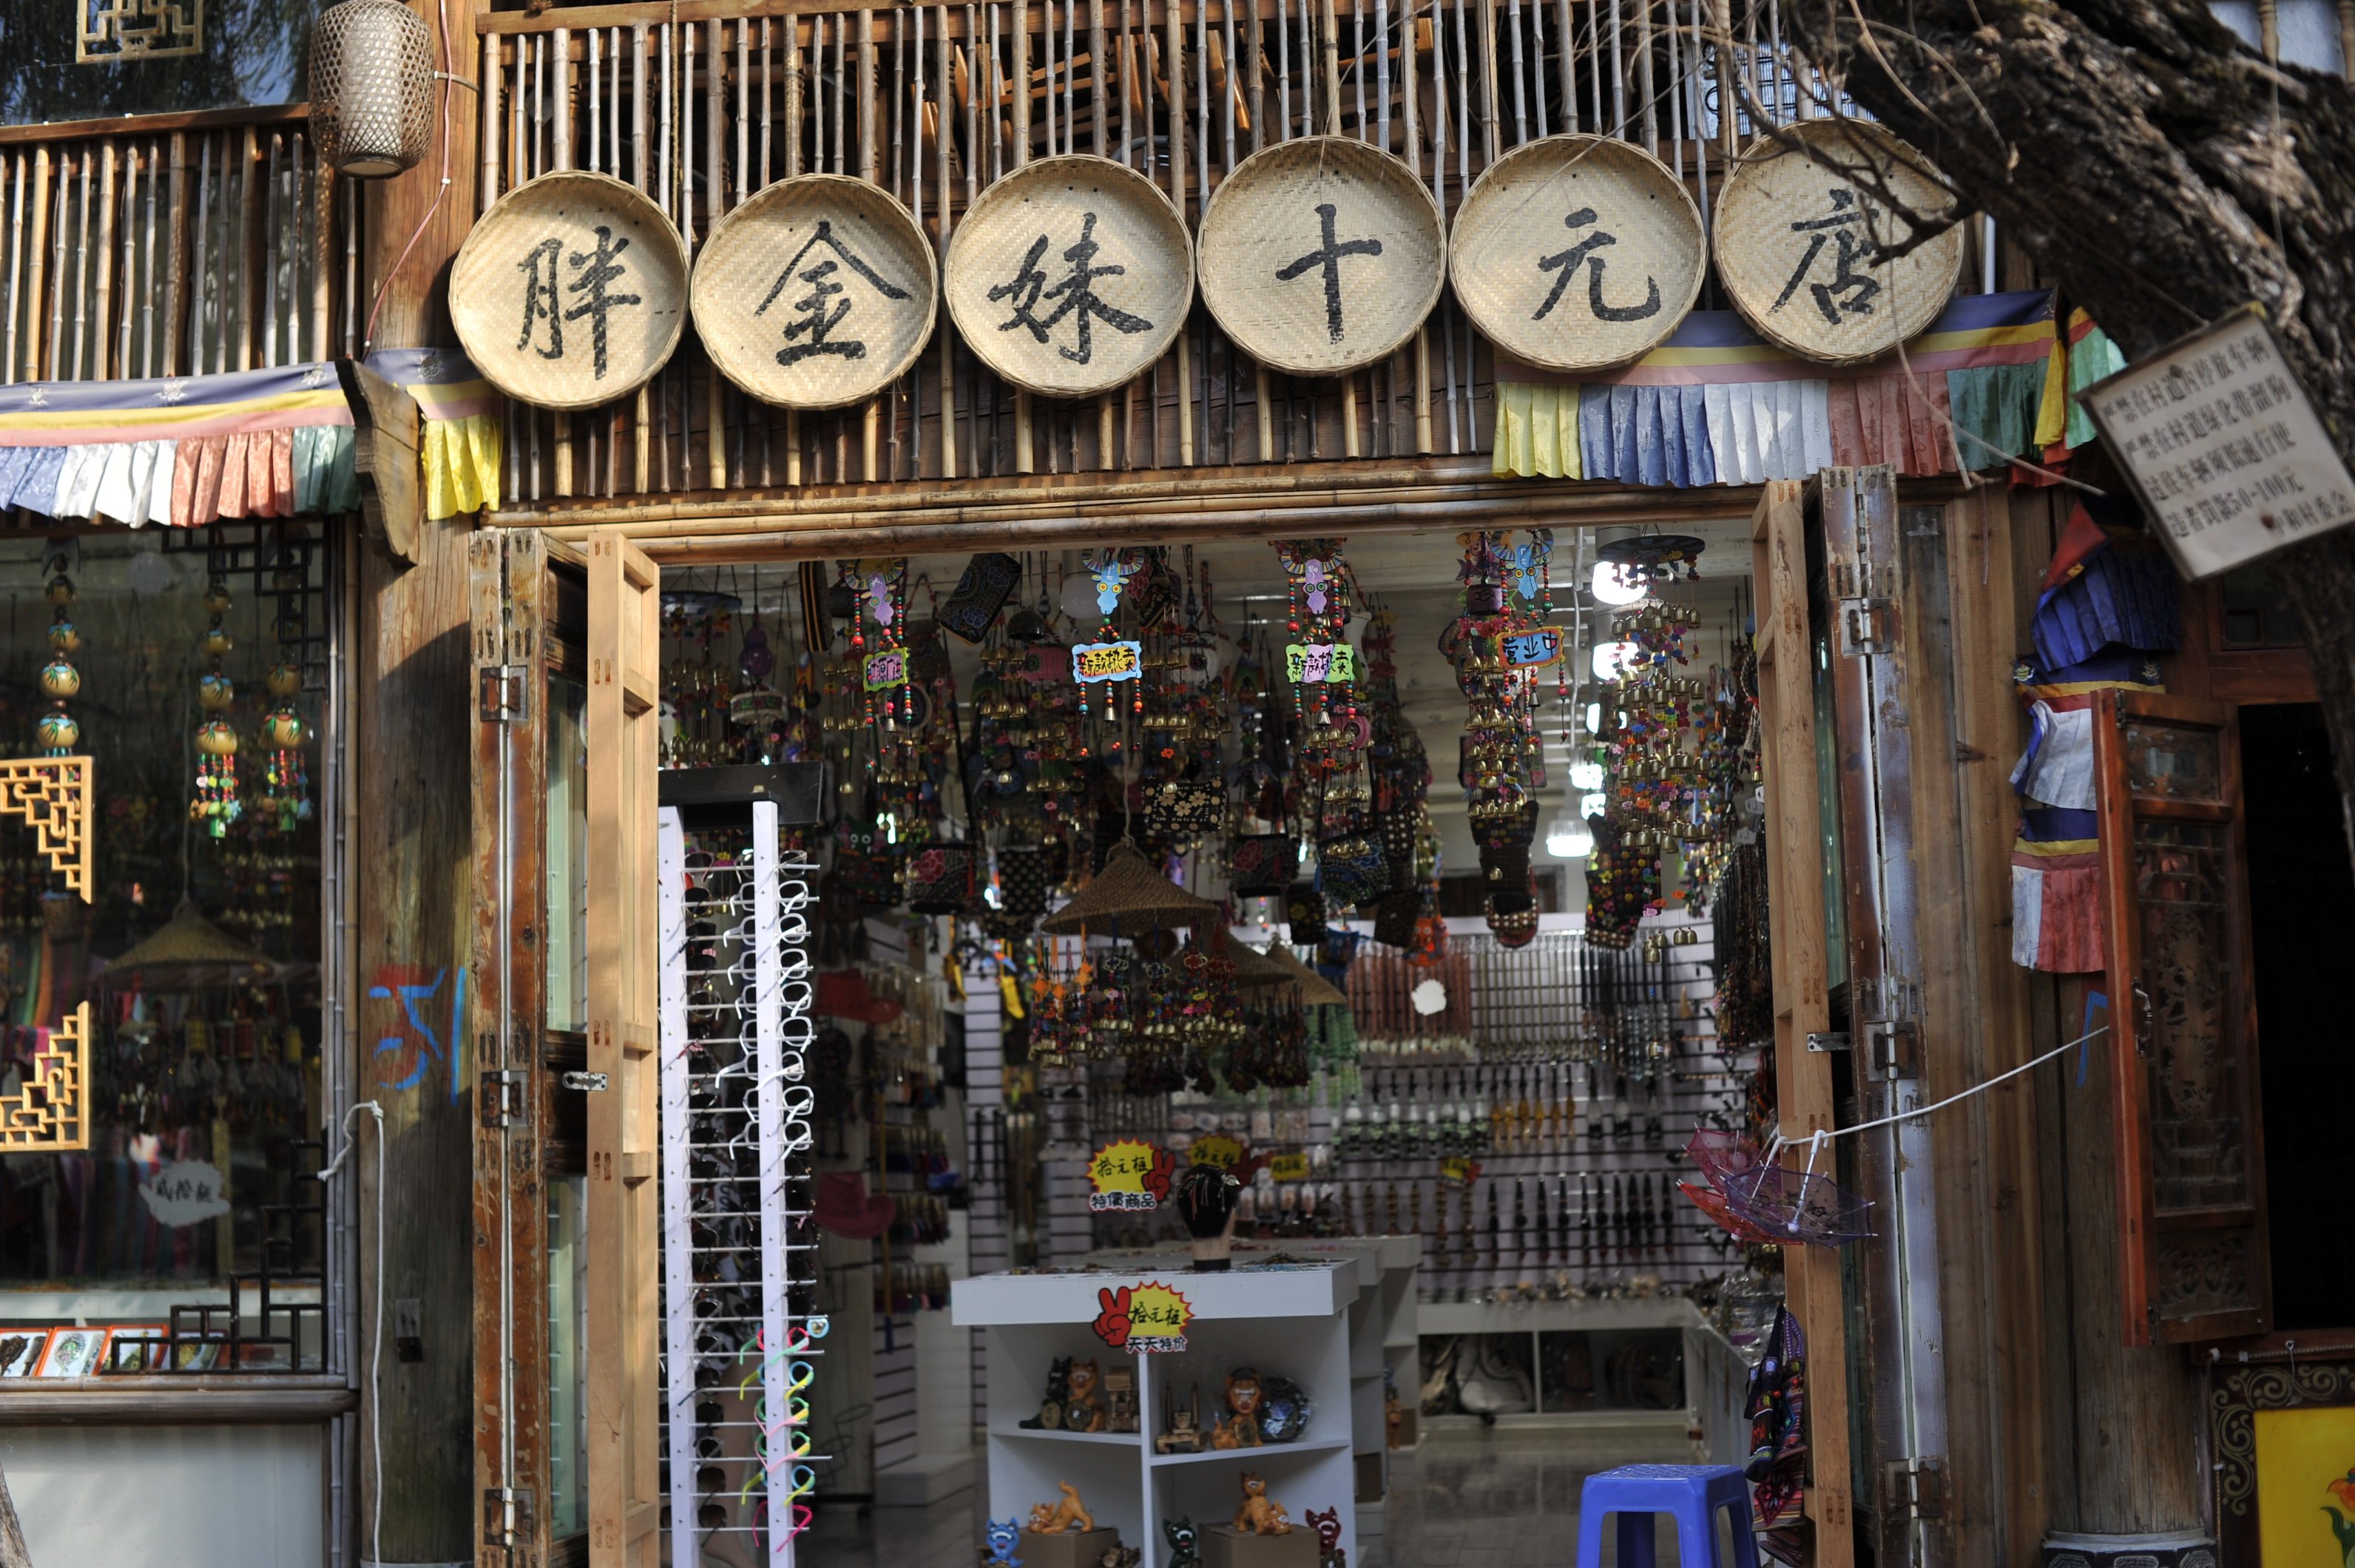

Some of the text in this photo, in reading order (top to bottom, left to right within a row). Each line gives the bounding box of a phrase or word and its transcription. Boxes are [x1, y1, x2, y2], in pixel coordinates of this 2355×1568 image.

[516, 189, 1879, 379] 胖金妹十元店
[1502, 630, 1558, 666] 营业中
[1092, 1192, 1155, 1209] 特價商品
[1129, 1336, 1186, 1352] 天天特价
